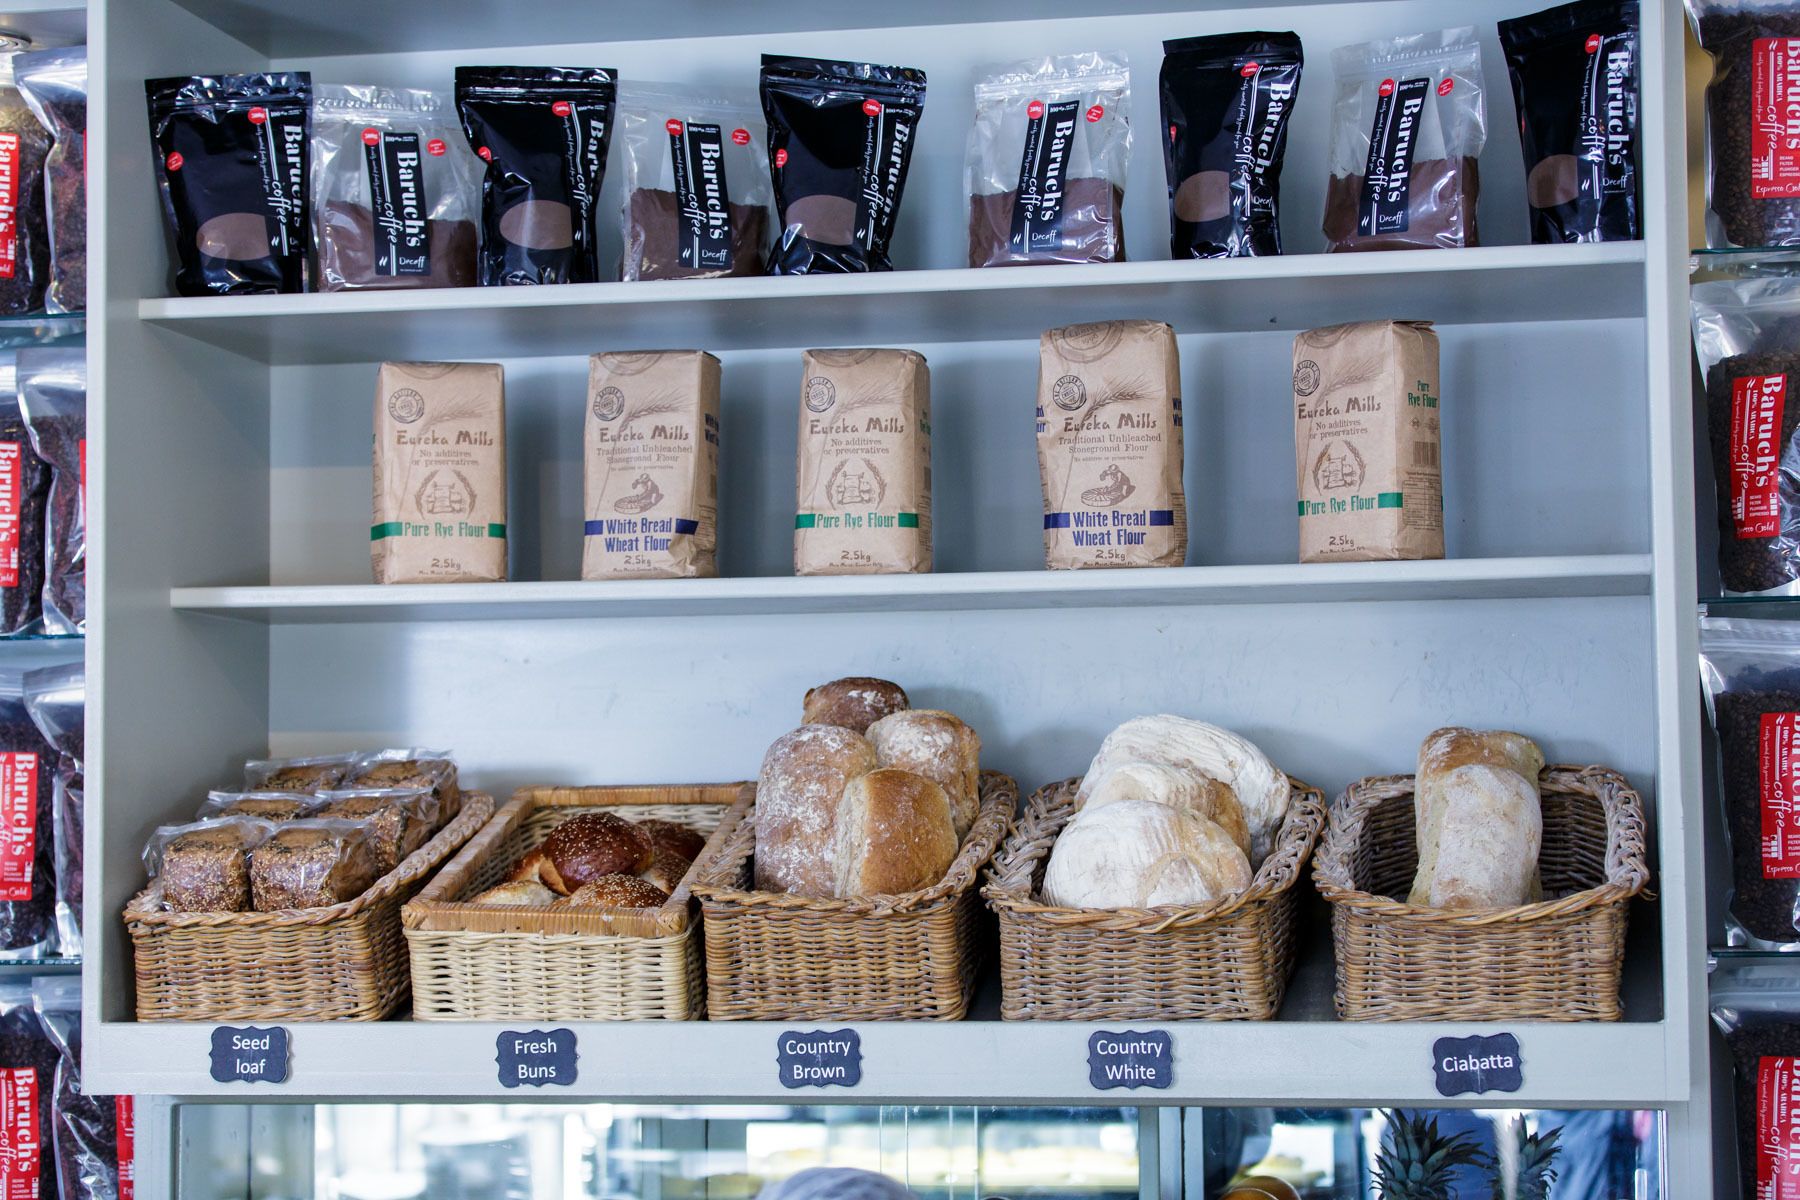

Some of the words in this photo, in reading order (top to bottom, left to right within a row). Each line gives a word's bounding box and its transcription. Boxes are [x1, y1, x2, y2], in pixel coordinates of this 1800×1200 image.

[1786, 40, 1800, 149] Baruchs
[1608, 52, 1630, 165] Baruch's
[1760, 106, 1784, 149] coffee
[1582, 117, 1605, 163] coffee
[1388, 97, 1423, 202] Baruch's
[1235, 136, 1253, 181] coffee
[1041, 119, 1074, 221] Baruch's
[0, 135, 16, 233] Baruch's
[1368, 158, 1388, 200] coffee
[1603, 175, 1628, 188] Decaff
[397, 152, 426, 246] Baruch's
[700, 142, 728, 239] Baruch's
[863, 174, 884, 218] coffee
[1020, 179, 1041, 219] coffee
[1756, 185, 1784, 197] Espresso
[267, 181, 292, 224] coffee
[379, 202, 403, 243] coffee
[683, 194, 707, 234] coffee
[1380, 211, 1403, 224] Decaff
[1032, 230, 1057, 242] Decaff
[702, 250, 727, 261] Decaff
[1417, 380, 1429, 392] Pure
[1298, 400, 1340, 420] Eureka
[1346, 396, 1381, 414] Mills
[1408, 392, 1421, 407] Rye
[1422, 394, 1438, 408] Flour
[810, 418, 858, 435] Eureka
[865, 417, 904, 434] Mills
[1064, 414, 1110, 432] Eureka
[1117, 413, 1157, 429] Mills
[1316, 421, 1326, 431] No
[1328, 419, 1360, 429] additives
[396, 430, 449, 445] Eureka
[455, 430, 494, 446] Mills
[600, 426, 644, 442] Eureka
[650, 425, 689, 440] Mills
[1058, 435, 1105, 445] Traditional
[1109, 433, 1162, 442] Unbleached
[1320, 427, 1368, 440] preservatives
[1755, 376, 1783, 487] Baruch's
[596, 445, 639, 456] Traditional
[642, 444, 692, 453] Unbleached
[831, 439, 842, 448] No
[845, 438, 882, 446] additives
[835, 446, 889, 456] preservatives
[1068, 444, 1120, 454] Stoneground
[1125, 444, 1149, 452] Flour
[420, 450, 432, 458] No
[435, 449, 471, 458] additives
[425, 458, 479, 468] preservatives
[1736, 444, 1755, 488] coffee
[0, 443, 17, 542] Baruch's
[1306, 500, 1326, 516] Pure
[1330, 498, 1346, 513] Rye
[1351, 495, 1376, 511] Flour
[606, 519, 638, 534] White
[641, 518, 672, 533] Bread
[816, 513, 840, 529] Pure
[844, 513, 862, 530] Rye
[868, 512, 895, 528] Flour
[1072, 512, 1108, 528] White
[1112, 510, 1146, 526] Bread
[1755, 521, 1775, 533] Gold
[404, 523, 429, 537] Pure
[435, 522, 453, 539] Rye
[459, 522, 485, 537] Flour
[1072, 531, 1112, 546] Wheat
[1117, 530, 1147, 545] Flour
[604, 537, 639, 552] Wheat
[644, 535, 671, 551] Flour
[1329, 536, 1354, 547] 2.5kg
[623, 555, 651, 566] 2.5kg
[841, 550, 871, 562] 2.5kg
[1095, 549, 1125, 561] 2.5kg
[431, 558, 461, 570] 2.5kg
[12, 754, 35, 855] Baruch's
[1768, 782, 1791, 827] coffee
[1767, 865, 1793, 877] Espresso
[232, 1035, 269, 1050] Seed
[515, 1040, 557, 1054] Fresh
[786, 1040, 851, 1059] Country
[1097, 1039, 1162, 1058] Country
[236, 1058, 266, 1074] loaf
[518, 1064, 556, 1078] Buns
[1442, 1054, 1513, 1072] Ciabatta
[793, 1065, 845, 1080] Brown
[1105, 1065, 1156, 1080] White
[14, 1070, 38, 1172] Baruch's
[0, 1130, 17, 1173] coffee
[1764, 1127, 1788, 1174] coffee
